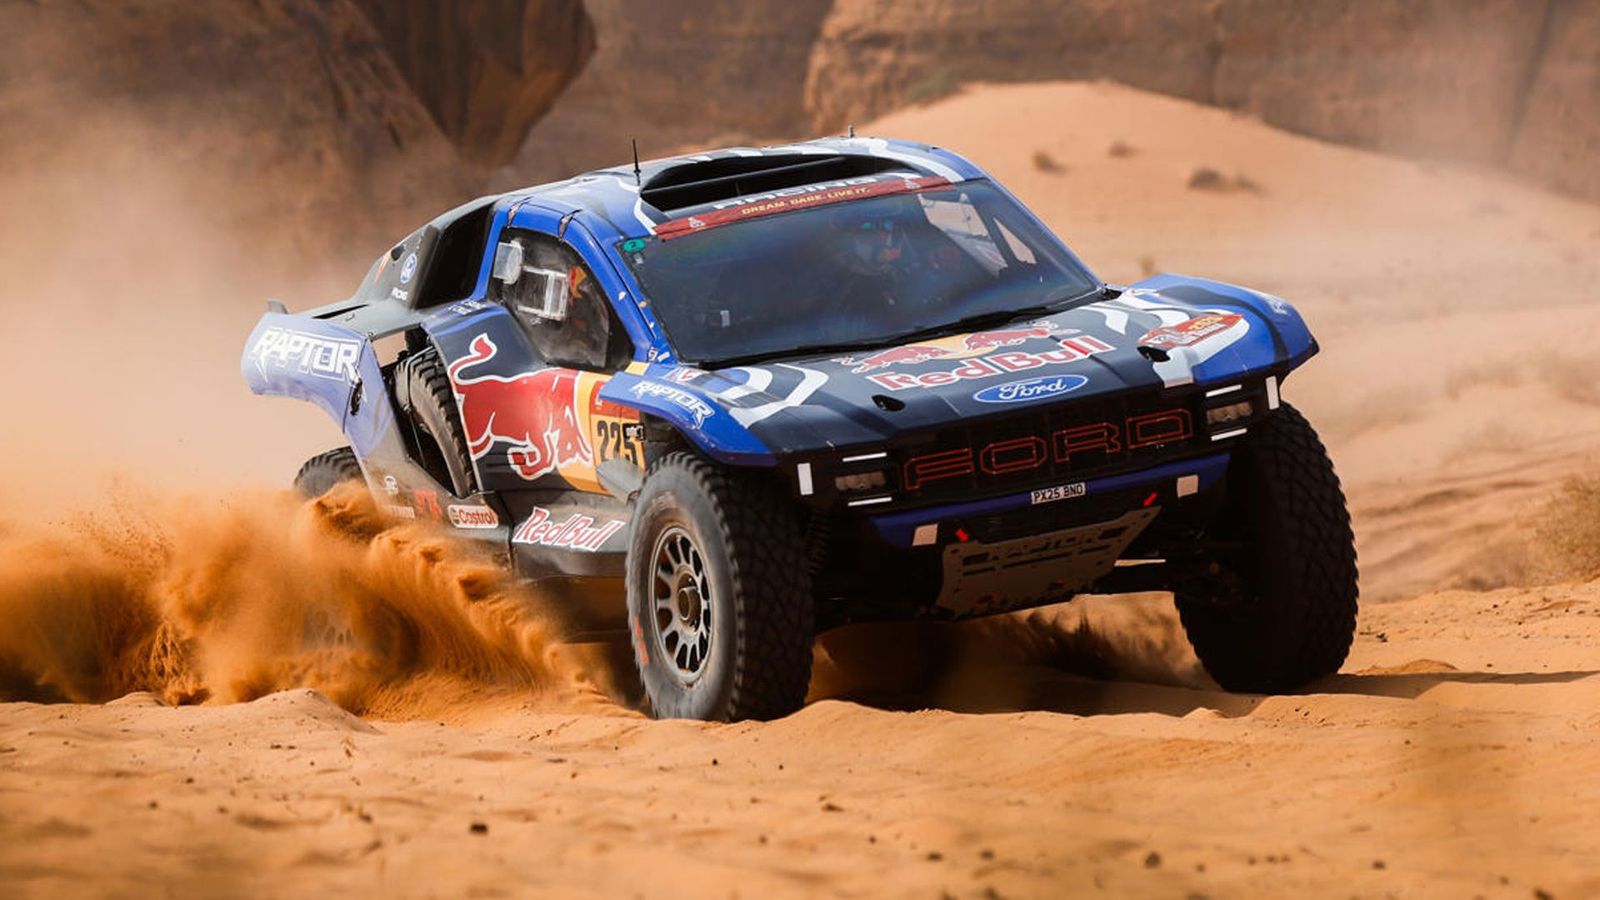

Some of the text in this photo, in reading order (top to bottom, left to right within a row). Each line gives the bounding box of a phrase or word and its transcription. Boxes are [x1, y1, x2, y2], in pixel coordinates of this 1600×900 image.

[741, 201, 787, 215] DREAM.
[789, 194, 826, 207] DARE.
[250, 326, 362, 386] RAPTOR
[867, 335, 1116, 391] Red Bull
[629, 380, 715, 430] RAPTOR
[998, 378, 1068, 401] Ford
[903, 408, 1194, 490] FORD
[458, 509, 497, 526] Castrol
[1033, 487, 1061, 502] PX25
[512, 506, 626, 553] Red Bull
